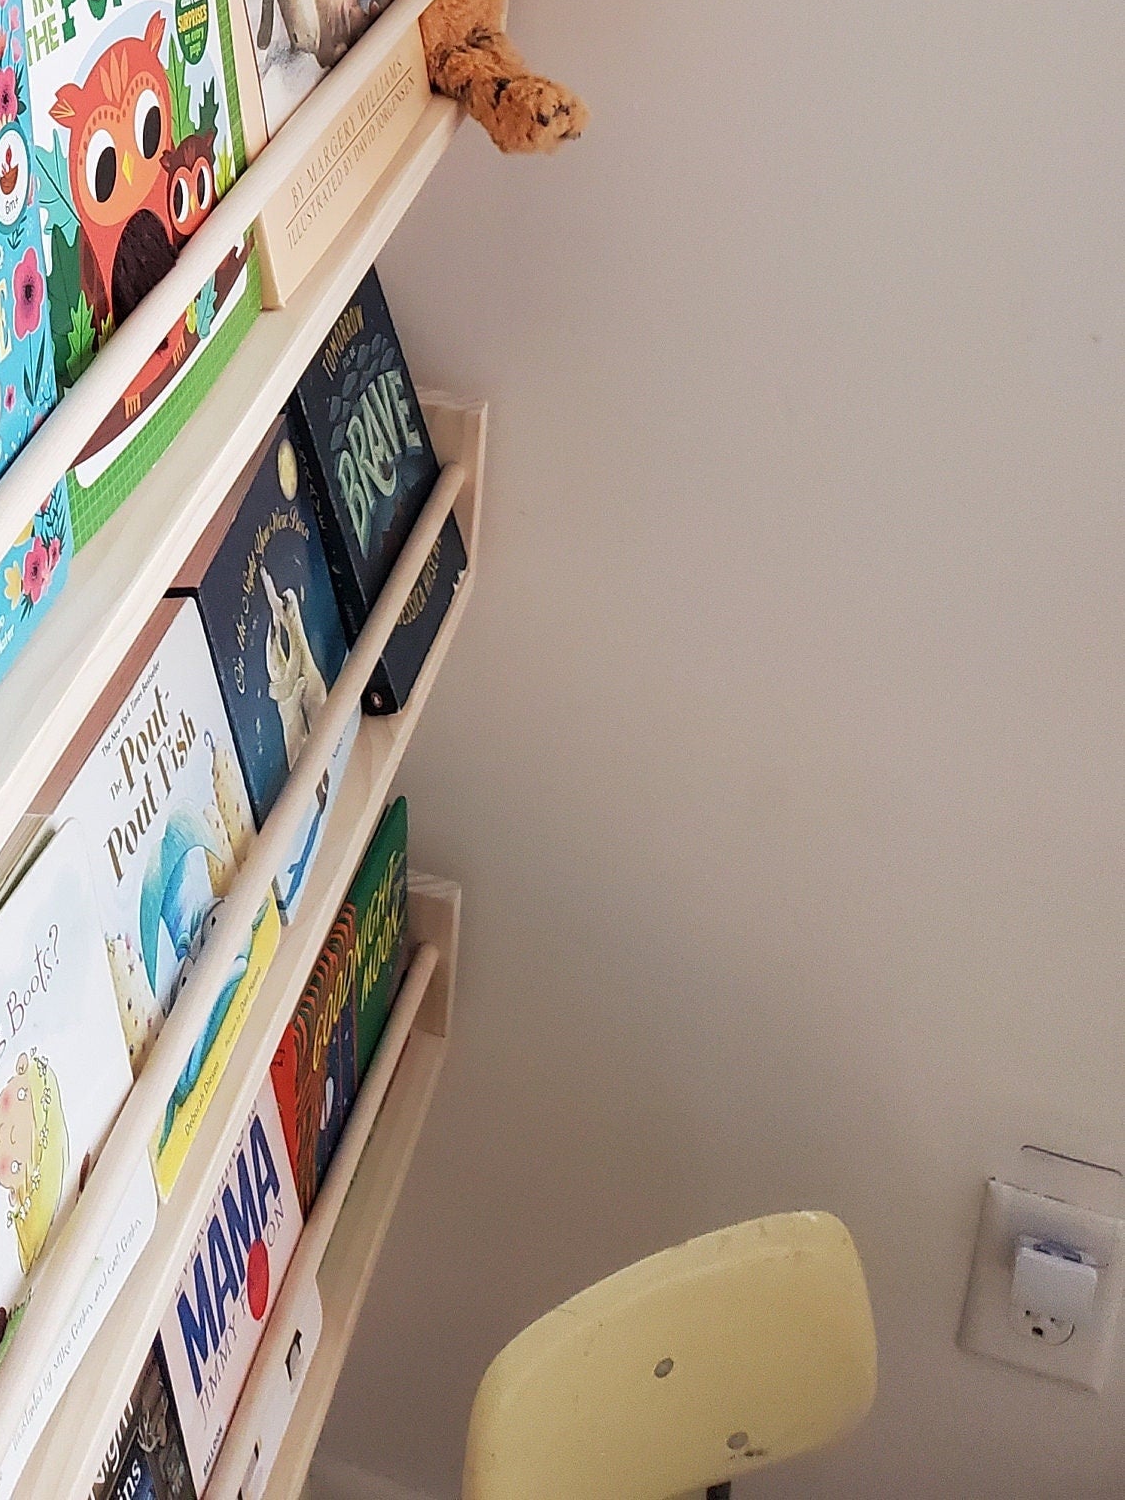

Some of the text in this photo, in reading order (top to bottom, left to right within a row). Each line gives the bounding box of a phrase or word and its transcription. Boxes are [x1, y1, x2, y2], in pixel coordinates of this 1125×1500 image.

[25, 13, 60, 67] THE
[287, 168, 342, 250] ILLUSTRATED
[354, 127, 379, 163] DAVID
[290, 54, 404, 209] BY MARGERY WILLIAMS
[322, 304, 365, 381] TOMORROW
[338, 368, 423, 559] BRAVE
[103, 708, 197, 887] Pout Fish
[110, 683, 170, 801] The Pout-
[5, 923, 61, 1039] Boots?
[176, 1114, 281, 1400] MAMA
[199, 1313, 237, 1431] JIMMY
